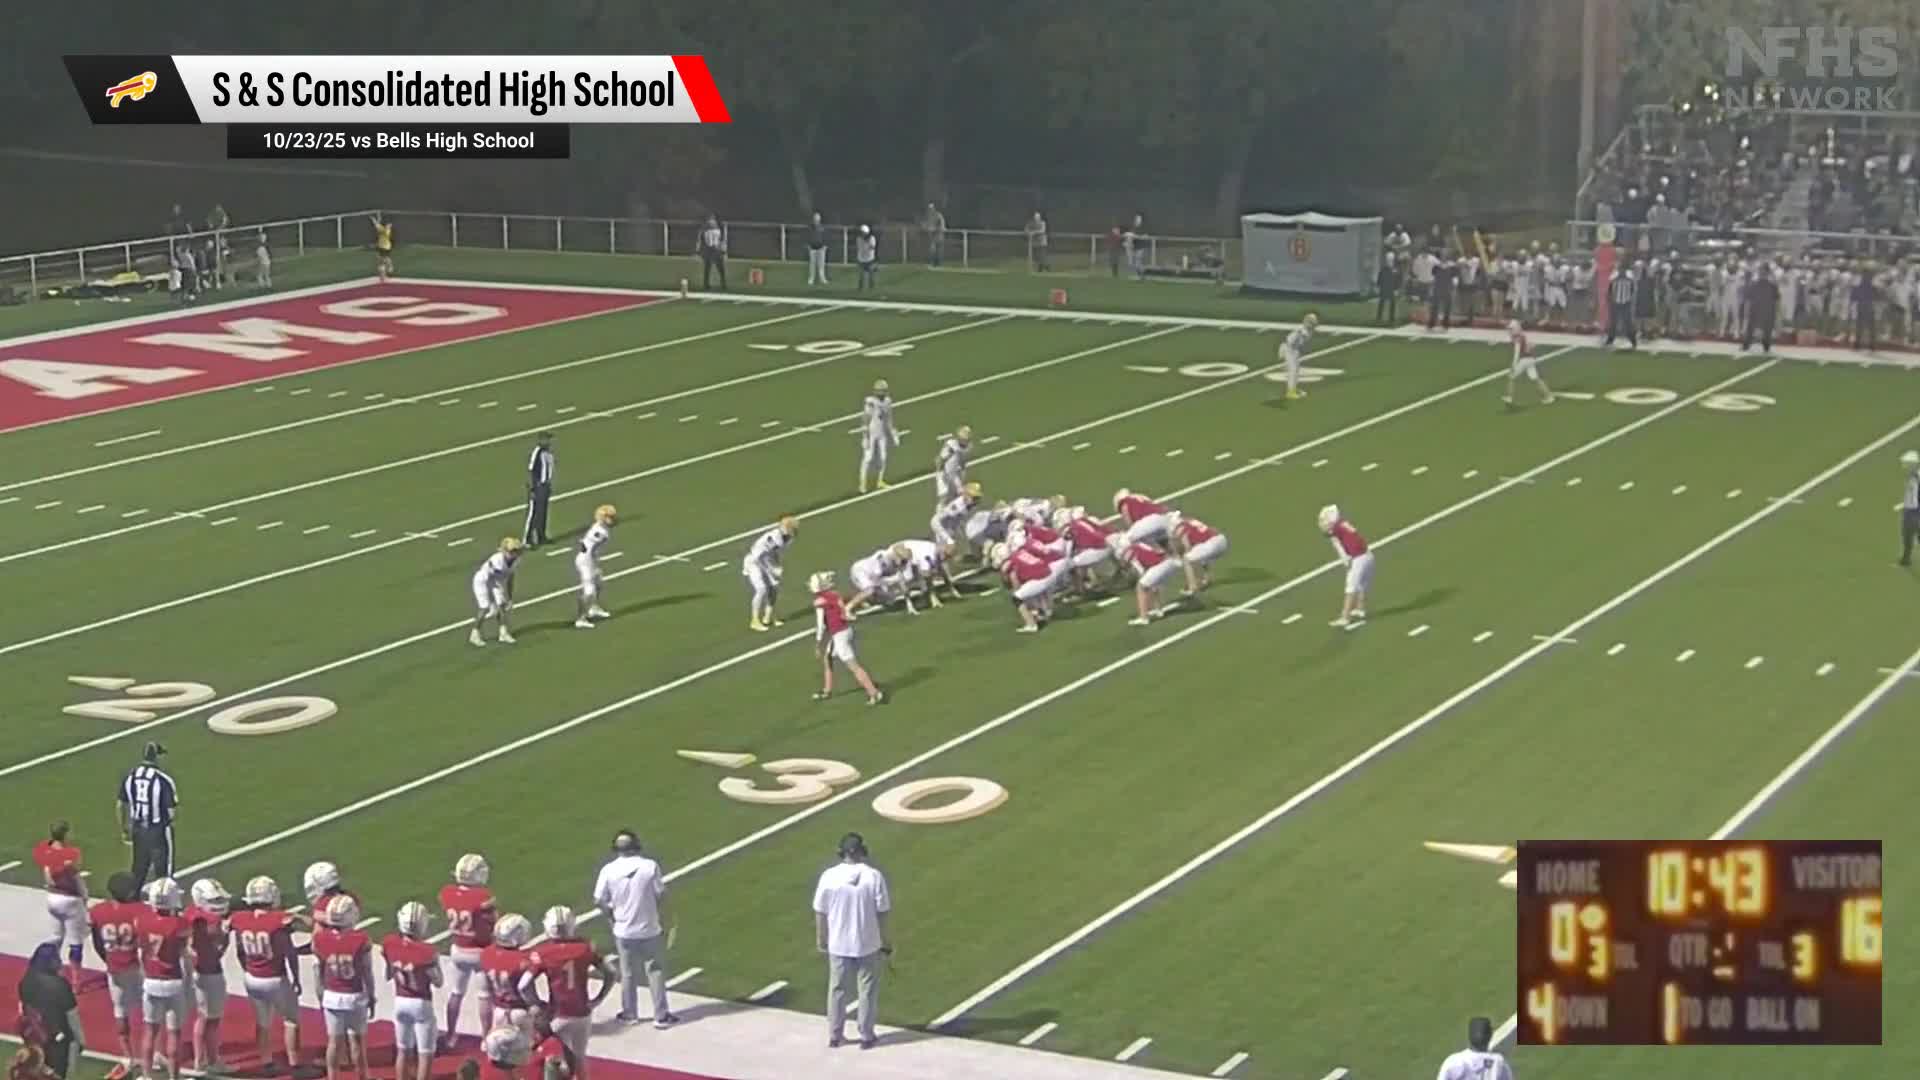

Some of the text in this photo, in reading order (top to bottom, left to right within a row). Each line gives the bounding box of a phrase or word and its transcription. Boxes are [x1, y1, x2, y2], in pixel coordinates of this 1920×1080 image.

[1536, 861, 1601, 893] HOME
[1648, 850, 1767, 915] 10:43
[1791, 856, 1882, 889] VISITOR
[1588, 935, 1608, 979] 3
[1669, 932, 1708, 970] QTR
[1791, 934, 1815, 979] 3
[1527, 982, 1609, 1044] 4 DOWN
[1708, 996, 1733, 1030] GO
[1746, 996, 1821, 1031] BALL ON
